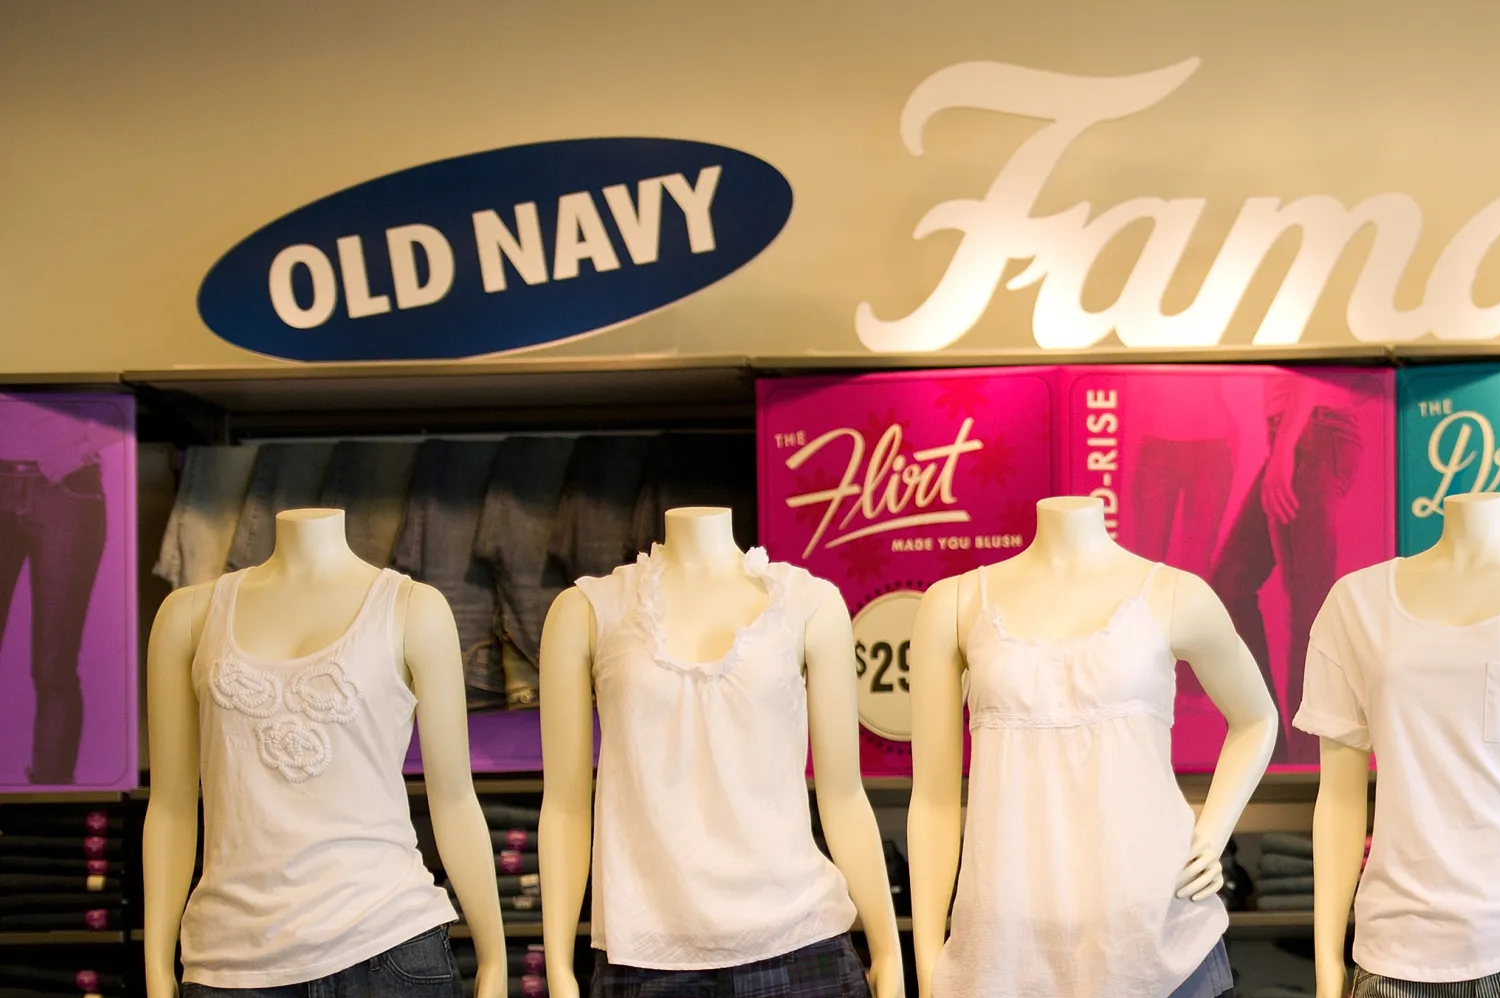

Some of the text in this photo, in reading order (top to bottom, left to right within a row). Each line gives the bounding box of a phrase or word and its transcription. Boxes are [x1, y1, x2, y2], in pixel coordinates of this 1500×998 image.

[268, 164, 723, 330] OLD NAVY
[774, 430, 806, 449] THE
[1418, 398, 1453, 418] THE
[785, 416, 984, 560] Flirt
[1086, 389, 1119, 541] D-RISE
[892, 534, 1022, 552] MADE YOU BLUSH
